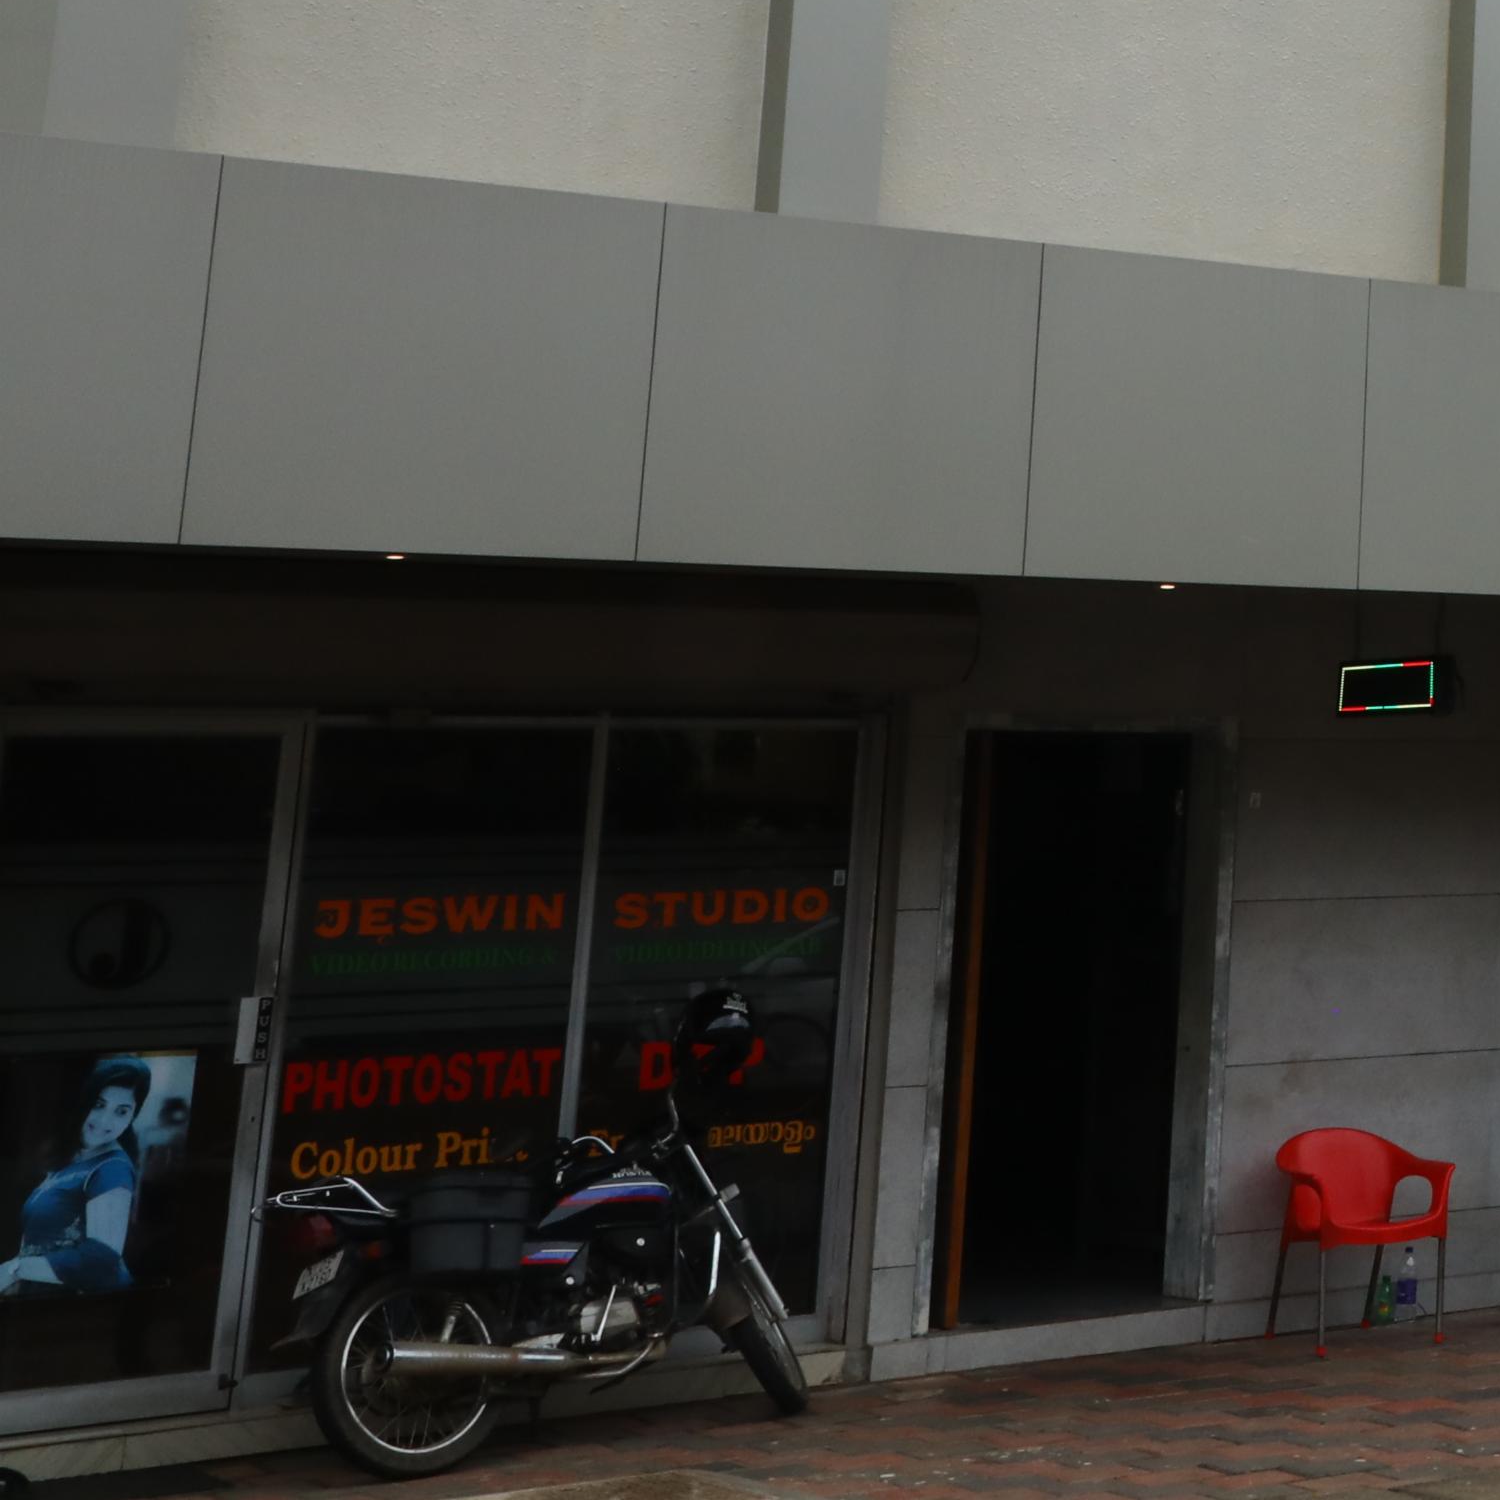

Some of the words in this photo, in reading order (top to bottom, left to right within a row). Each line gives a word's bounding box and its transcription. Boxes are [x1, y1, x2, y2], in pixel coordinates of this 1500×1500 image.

[313, 890, 567, 940] JESWIN
[611, 885, 832, 930] STUDIO
[309, 951, 389, 976] VIDEO
[393, 947, 533, 972] RECORDING
[255, 999, 271, 1060] PUSH
[284, 1047, 562, 1113] PHOTOSTAT
[291, 1133, 421, 1180] Colour
[707, 1118, 817, 1154] മലയാളം
